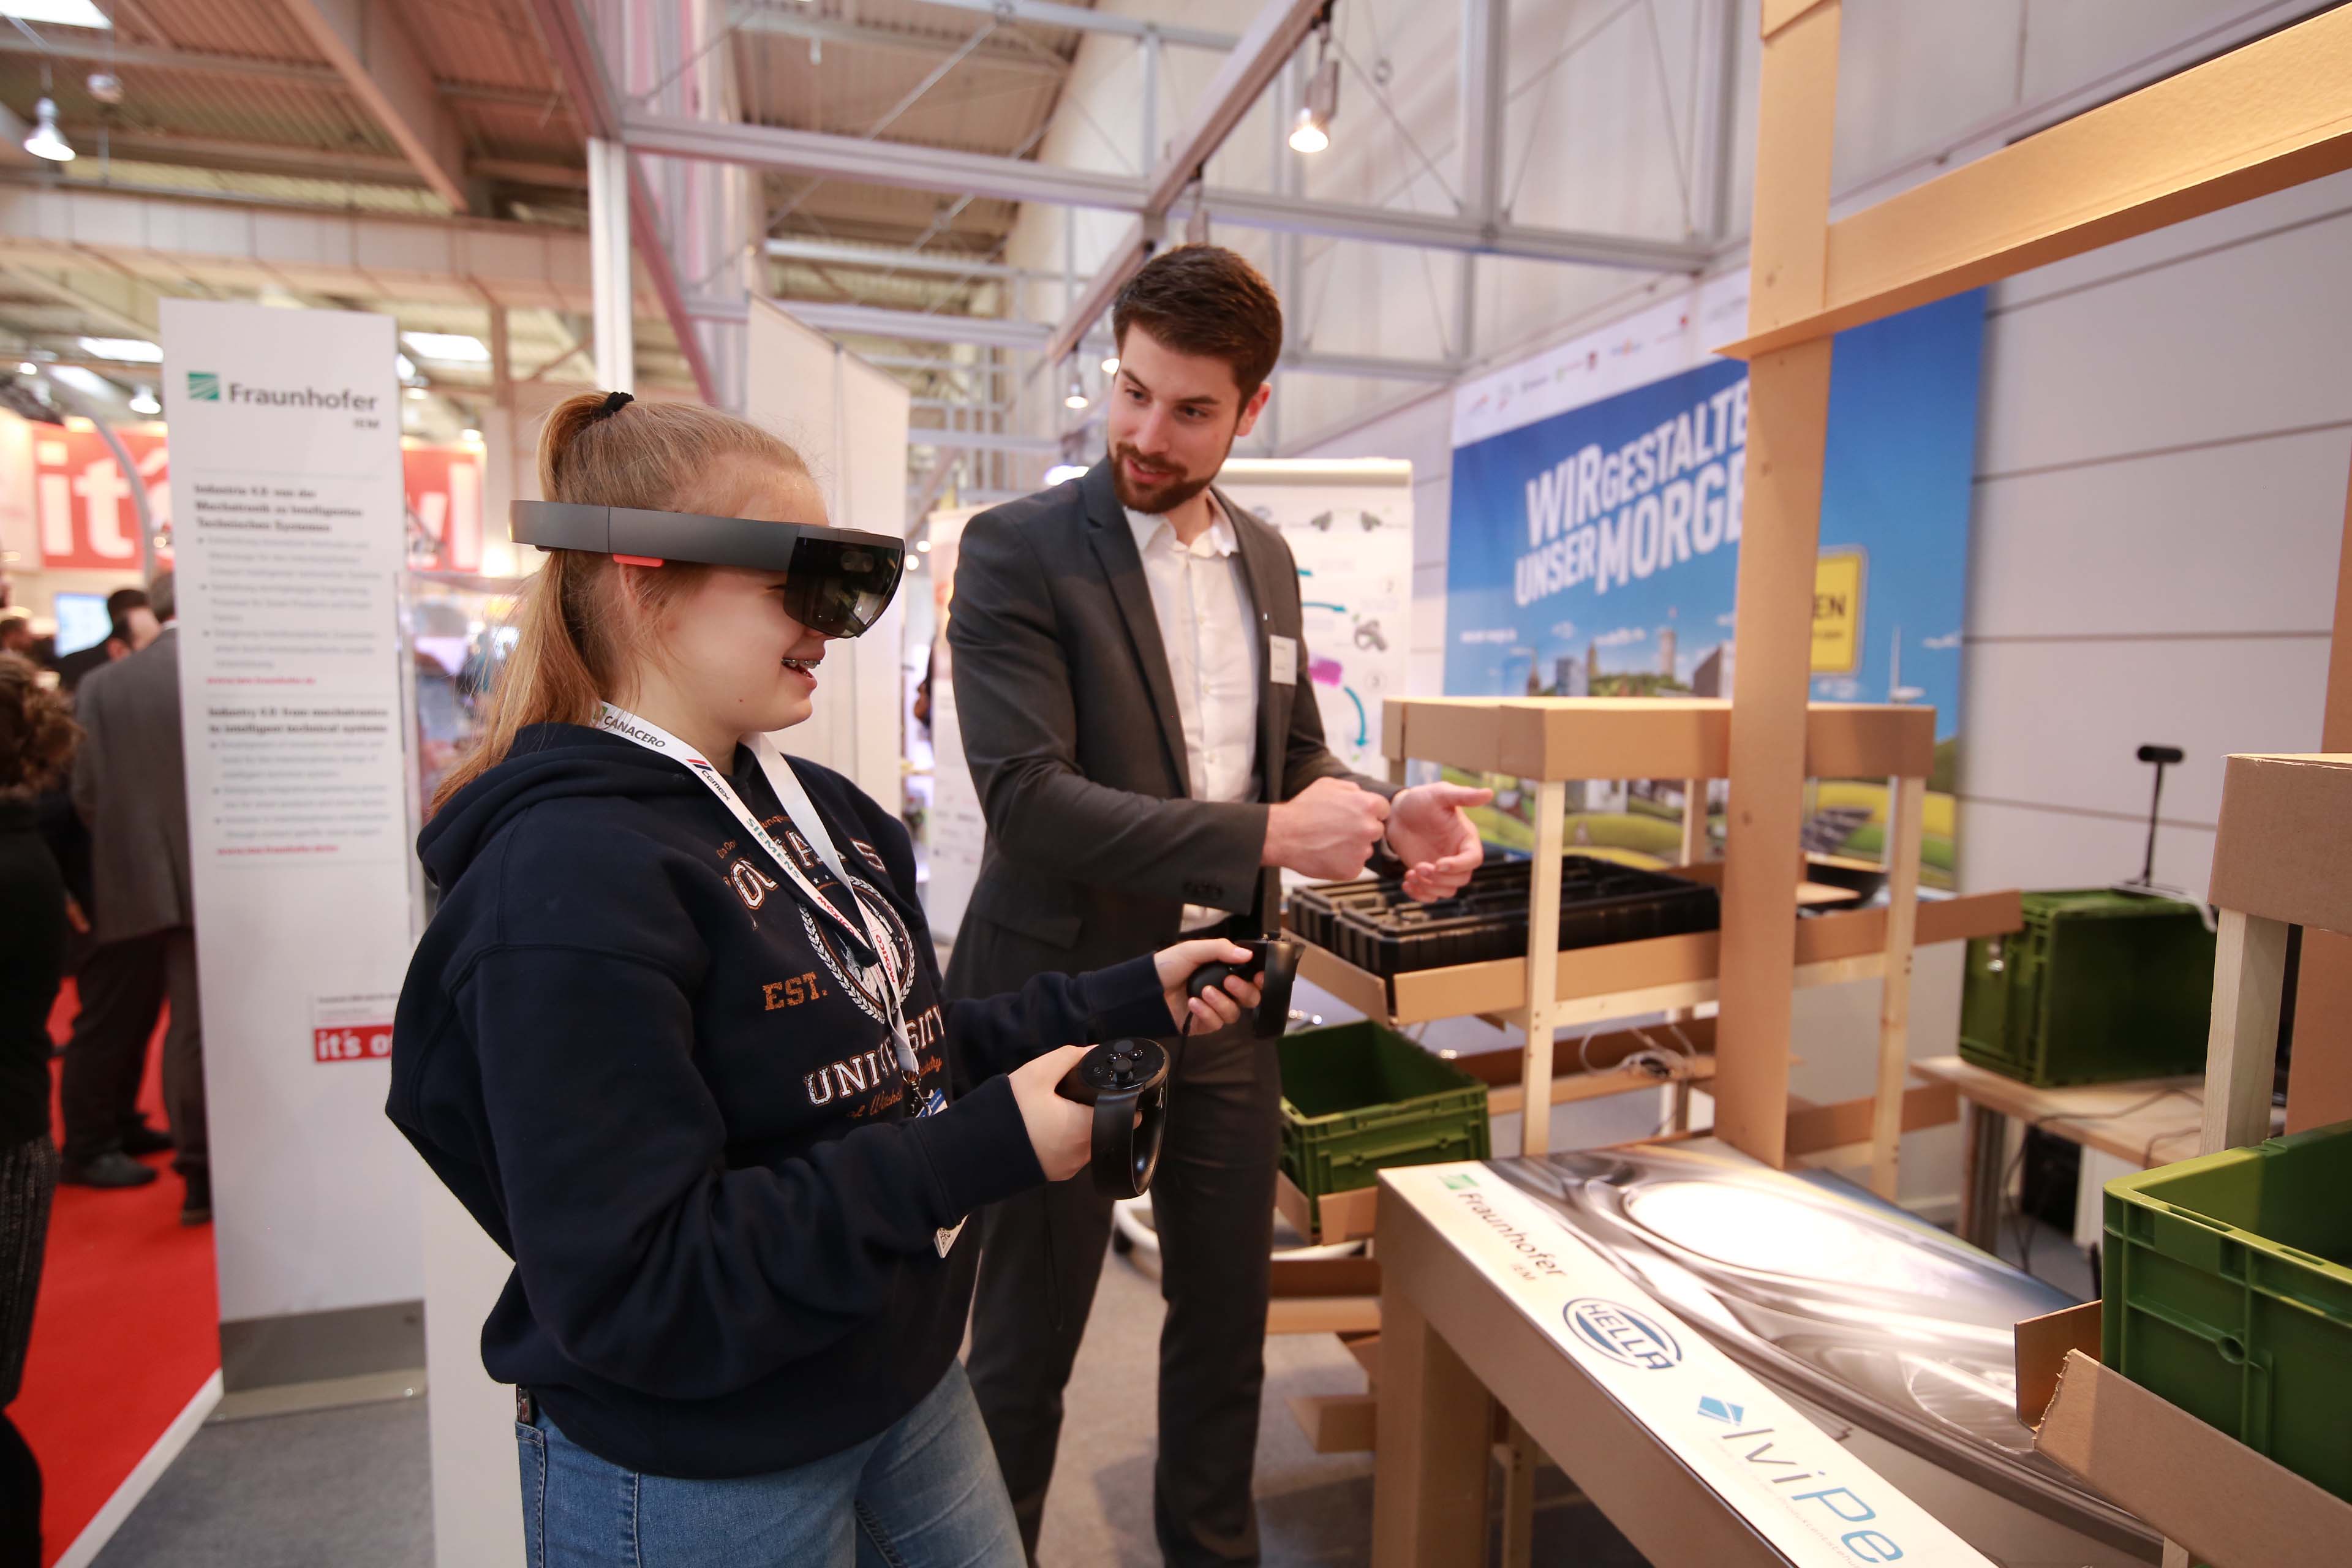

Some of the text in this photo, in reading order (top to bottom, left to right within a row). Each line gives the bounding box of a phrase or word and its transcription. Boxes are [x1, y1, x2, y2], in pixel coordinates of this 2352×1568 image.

[229, 383, 378, 410] Fraunhofer
[1526, 379, 1749, 548] WIR GESTALTE
[1514, 450, 1746, 606] UNSER MORGE
[1812, 594, 1846, 619] EN
[604, 715, 666, 748] CANACERO
[747, 818, 801, 879] SIEMENS
[761, 971, 828, 1011] EST.
[317, 1030, 363, 1059] it's
[1458, 1191, 1567, 1277] Fraunhofer
[1581, 1303, 1675, 1370] HELLA
